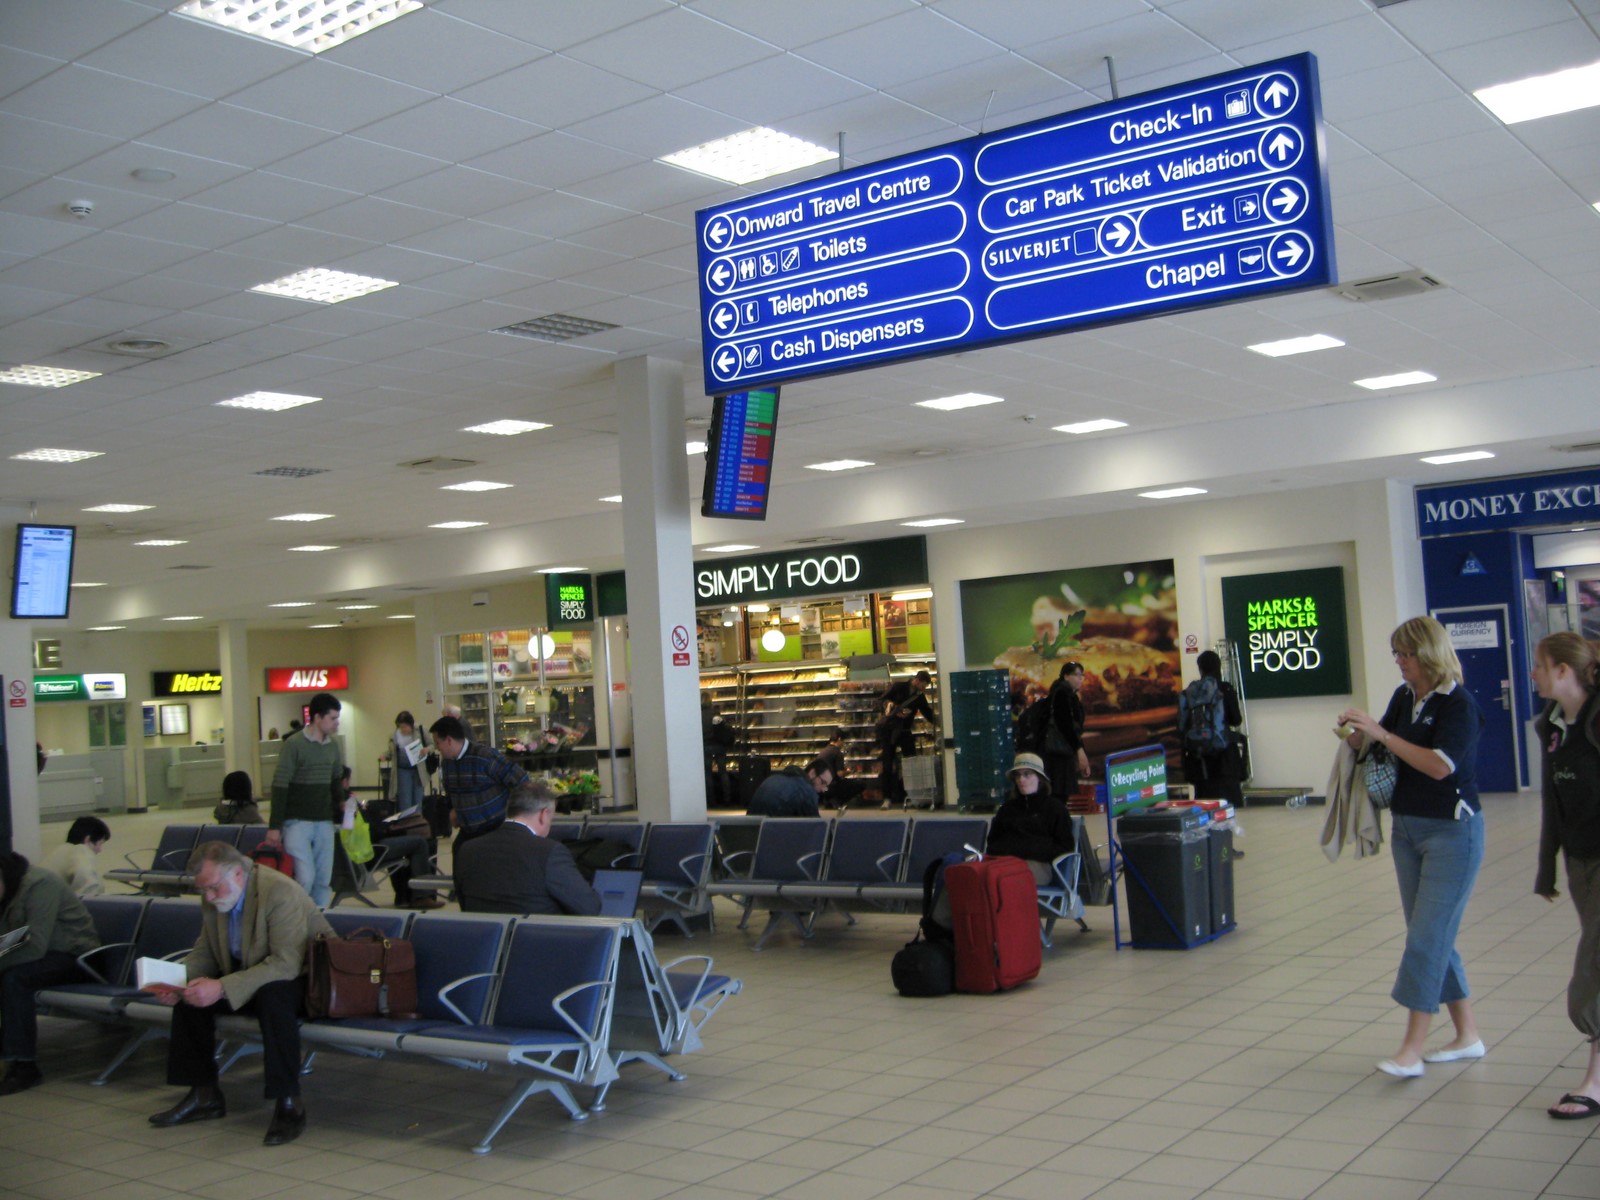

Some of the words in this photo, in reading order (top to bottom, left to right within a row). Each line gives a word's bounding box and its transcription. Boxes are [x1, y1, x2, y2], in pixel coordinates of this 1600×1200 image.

[1109, 105, 1213, 144] Check-In
[1005, 197, 1036, 217] Car
[1043, 183, 1084, 209] Park
[1090, 169, 1152, 198] Ticket
[1157, 147, 1256, 183] Validation
[735, 203, 803, 237] Onward
[809, 191, 861, 218] Travel
[867, 175, 931, 204] Centre
[1181, 203, 1227, 232] Exit
[809, 235, 867, 262] Toilets
[989, 236, 1071, 266] SILVERJET
[1145, 253, 1226, 289] Chapel
[768, 282, 868, 317] Telephones
[771, 336, 816, 361] Cash
[821, 316, 925, 351] Dispensers
[1424, 492, 1525, 524] MONEY
[698, 563, 780, 598] SIMPLY
[787, 554, 860, 588] FOOD
[560, 600, 584, 609] SIMPLY
[561, 609, 585, 619] FOOD
[1247, 598, 1302, 616] MARKS
[1248, 612, 1318, 632] SPENCER
[1451, 628, 1491, 637] CURRENCY
[1249, 629, 1318, 651] SIMPLY
[1251, 647, 1321, 673] FOOD
[171, 673, 222, 693] Hertz
[288, 670, 328, 688] AVIS
[1117, 768, 1148, 786] Recycling
[1148, 763, 1165, 778] Point
